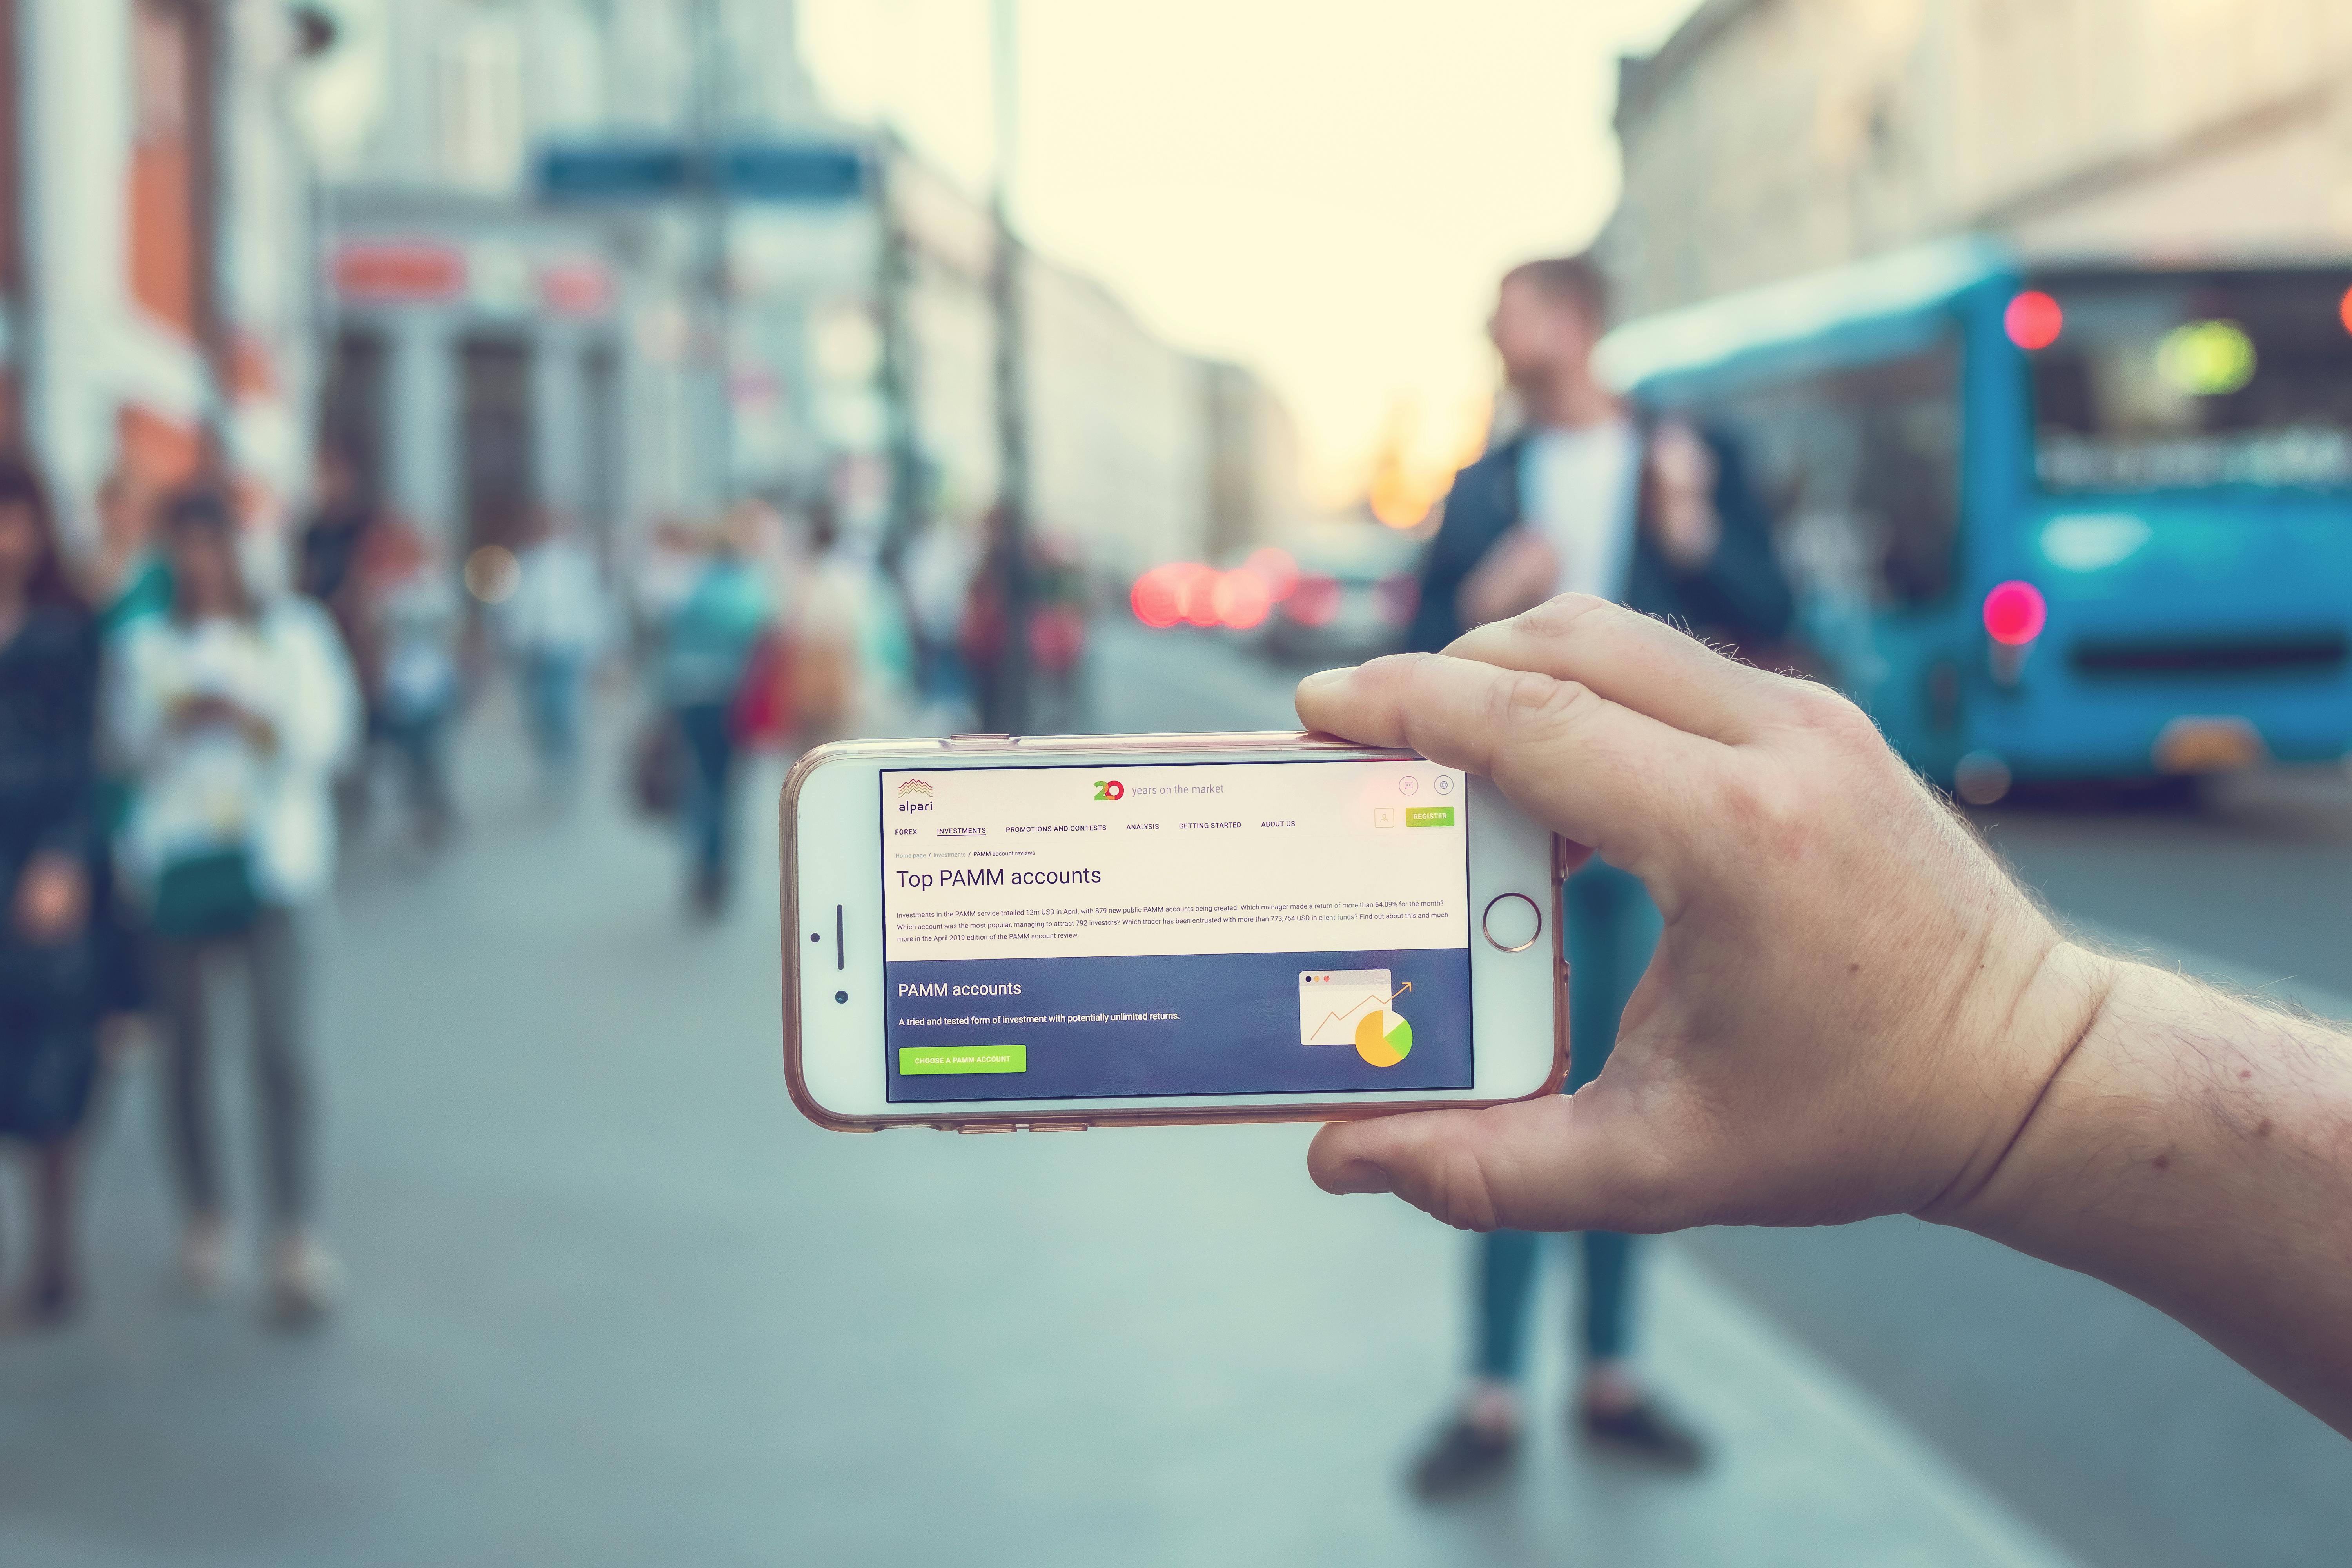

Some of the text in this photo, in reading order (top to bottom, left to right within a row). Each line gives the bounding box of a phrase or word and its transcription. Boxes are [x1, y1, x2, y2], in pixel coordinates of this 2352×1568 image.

[1094, 780, 1124, 801] 20
[1132, 787, 1157, 797] years
[1174, 784, 1189, 794] the
[1192, 784, 1224, 793] market
[899, 800, 933, 814] alpari
[896, 868, 1101, 891] Top PAMM accounts
[898, 982, 1022, 997] PAMM accounts
[906, 1017, 925, 1026] tried
[927, 1016, 942, 1025] and
[943, 1016, 969, 1025] tested
[971, 1016, 990, 1024] form
[992, 1015, 1001, 1024] of
[1002, 1015, 1047, 1024] investment
[1048, 1014, 1065, 1022] with
[1067, 1013, 1109, 1024] potentially
[1111, 1012, 1148, 1021] unlimited
